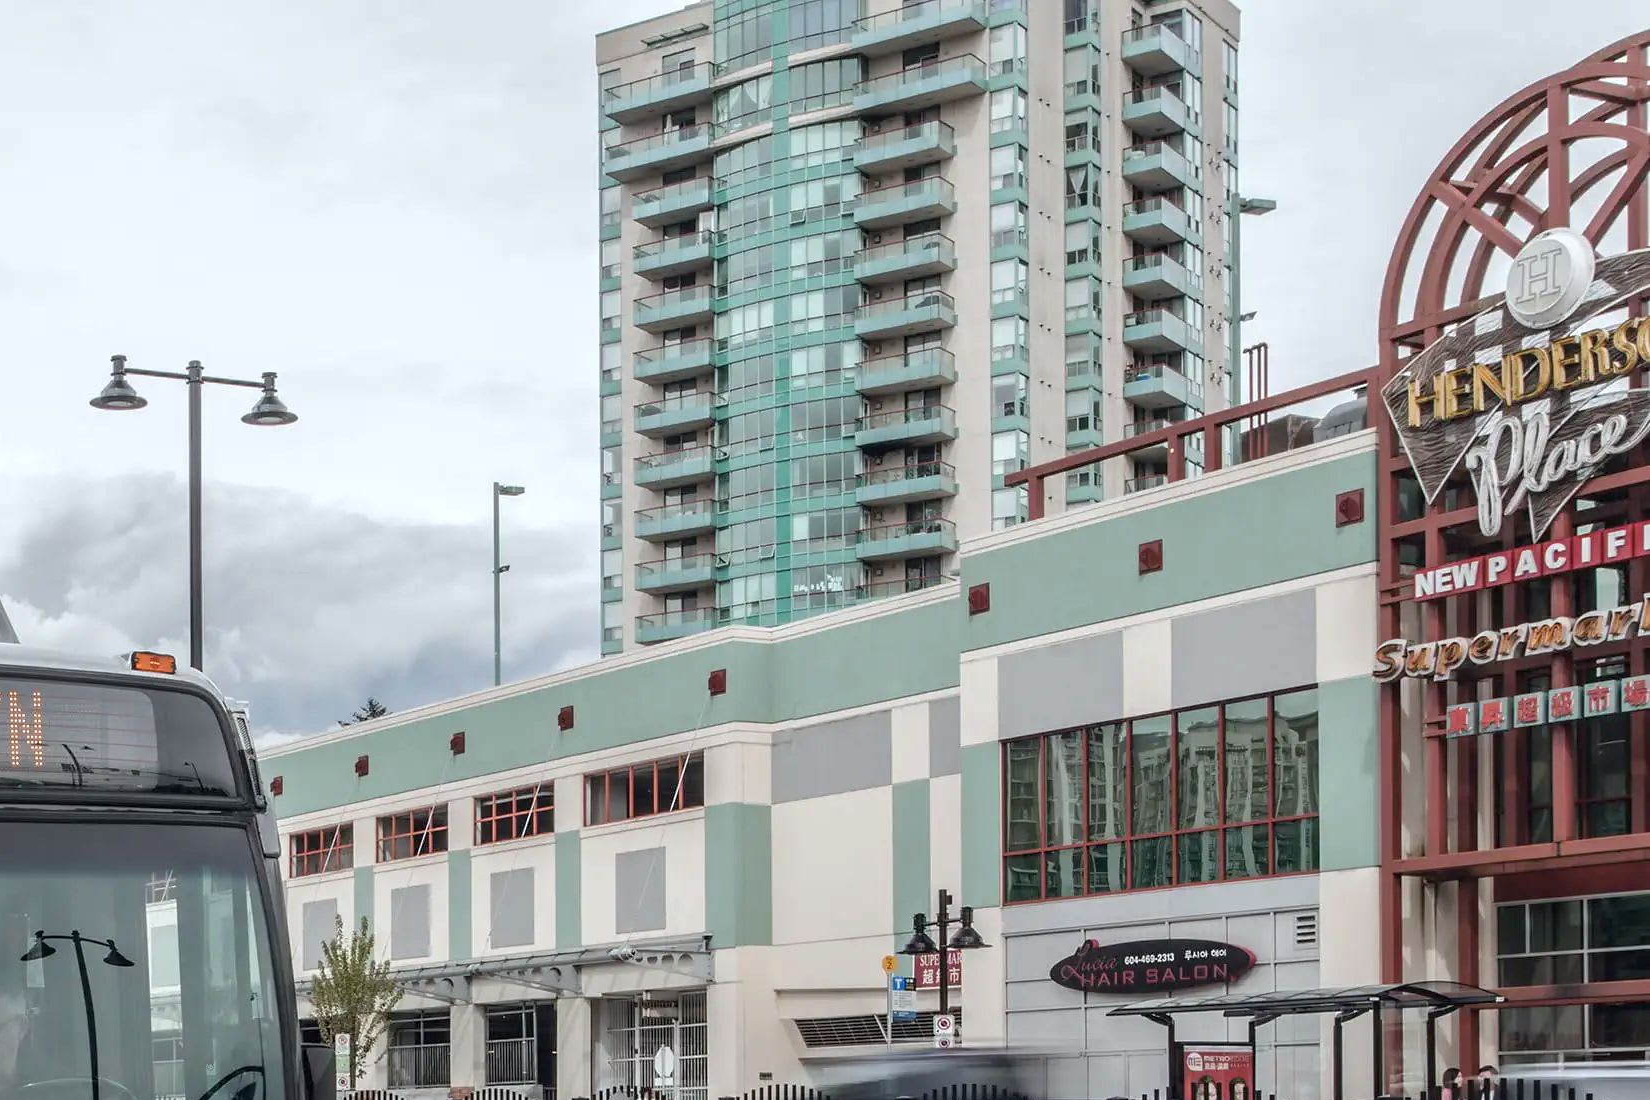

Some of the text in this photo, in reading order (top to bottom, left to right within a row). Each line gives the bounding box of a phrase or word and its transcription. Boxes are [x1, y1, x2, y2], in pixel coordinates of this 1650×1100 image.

[1466, 412, 1650, 537] Place
[1414, 560, 1479, 598] NEW
[1124, 952, 1175, 966] 604-469-2313
[1081, 964, 1228, 987] HAIR SALON
